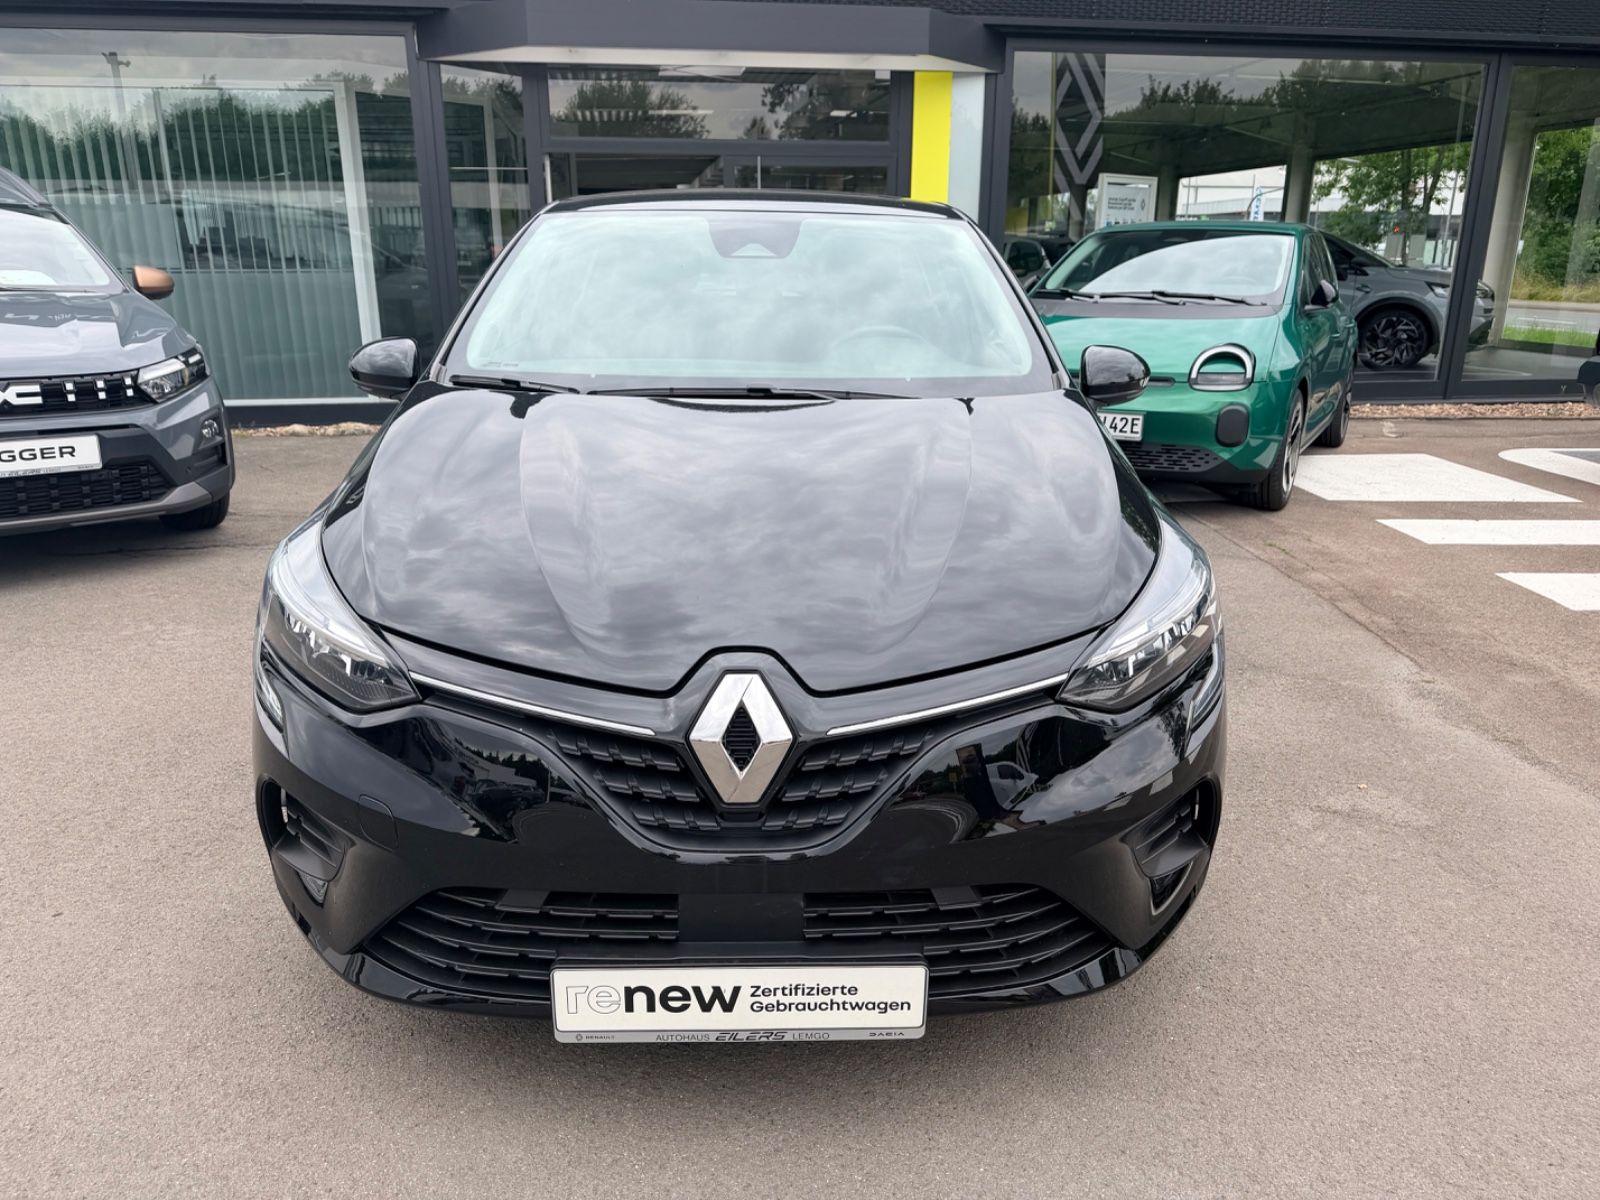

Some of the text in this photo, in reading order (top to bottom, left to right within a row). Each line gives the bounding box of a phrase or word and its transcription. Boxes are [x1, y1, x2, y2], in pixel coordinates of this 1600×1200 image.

[0, 445, 76, 463] GGER
[750, 983, 859, 998] Zertifizierte
[565, 985, 742, 1015] renew
[750, 998, 912, 1014] Gebrauchtwagen
[655, 1031, 830, 1042] AUTOHAUS EILERS LEMGO
